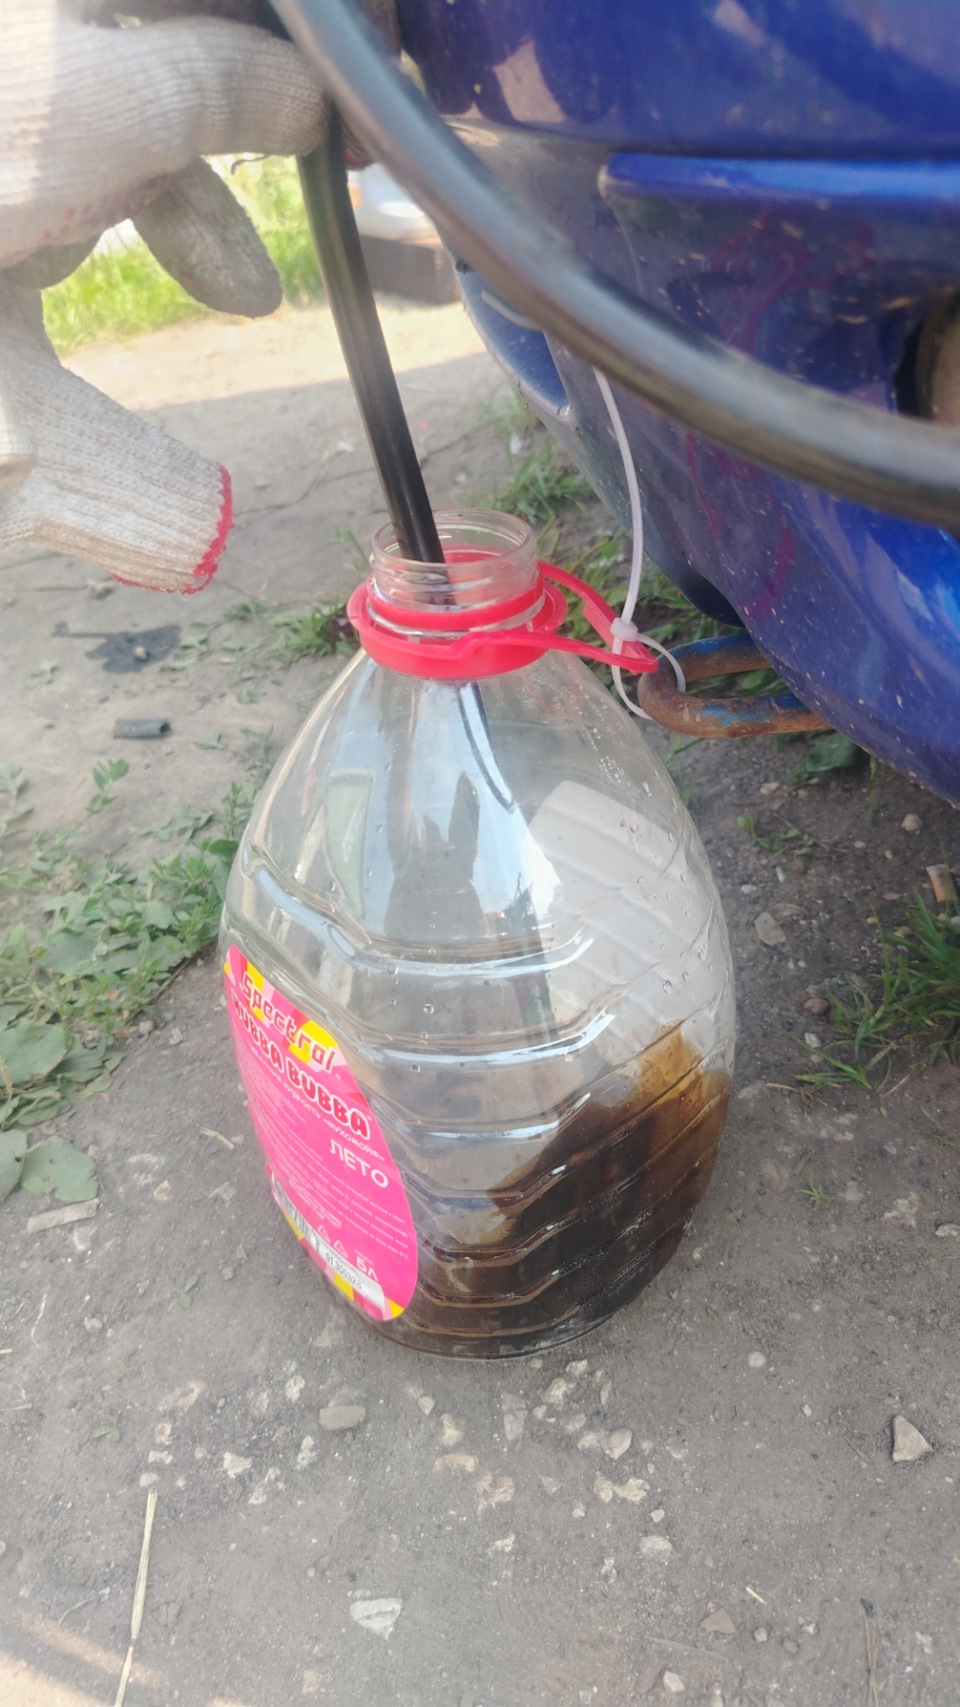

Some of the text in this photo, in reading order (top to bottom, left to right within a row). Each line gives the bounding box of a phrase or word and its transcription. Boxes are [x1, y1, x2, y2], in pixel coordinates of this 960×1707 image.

[239, 971, 336, 1074] Spectrol
[285, 1057, 370, 1140] BUBBA
[329, 1138, 388, 1188] ЛЕТО
